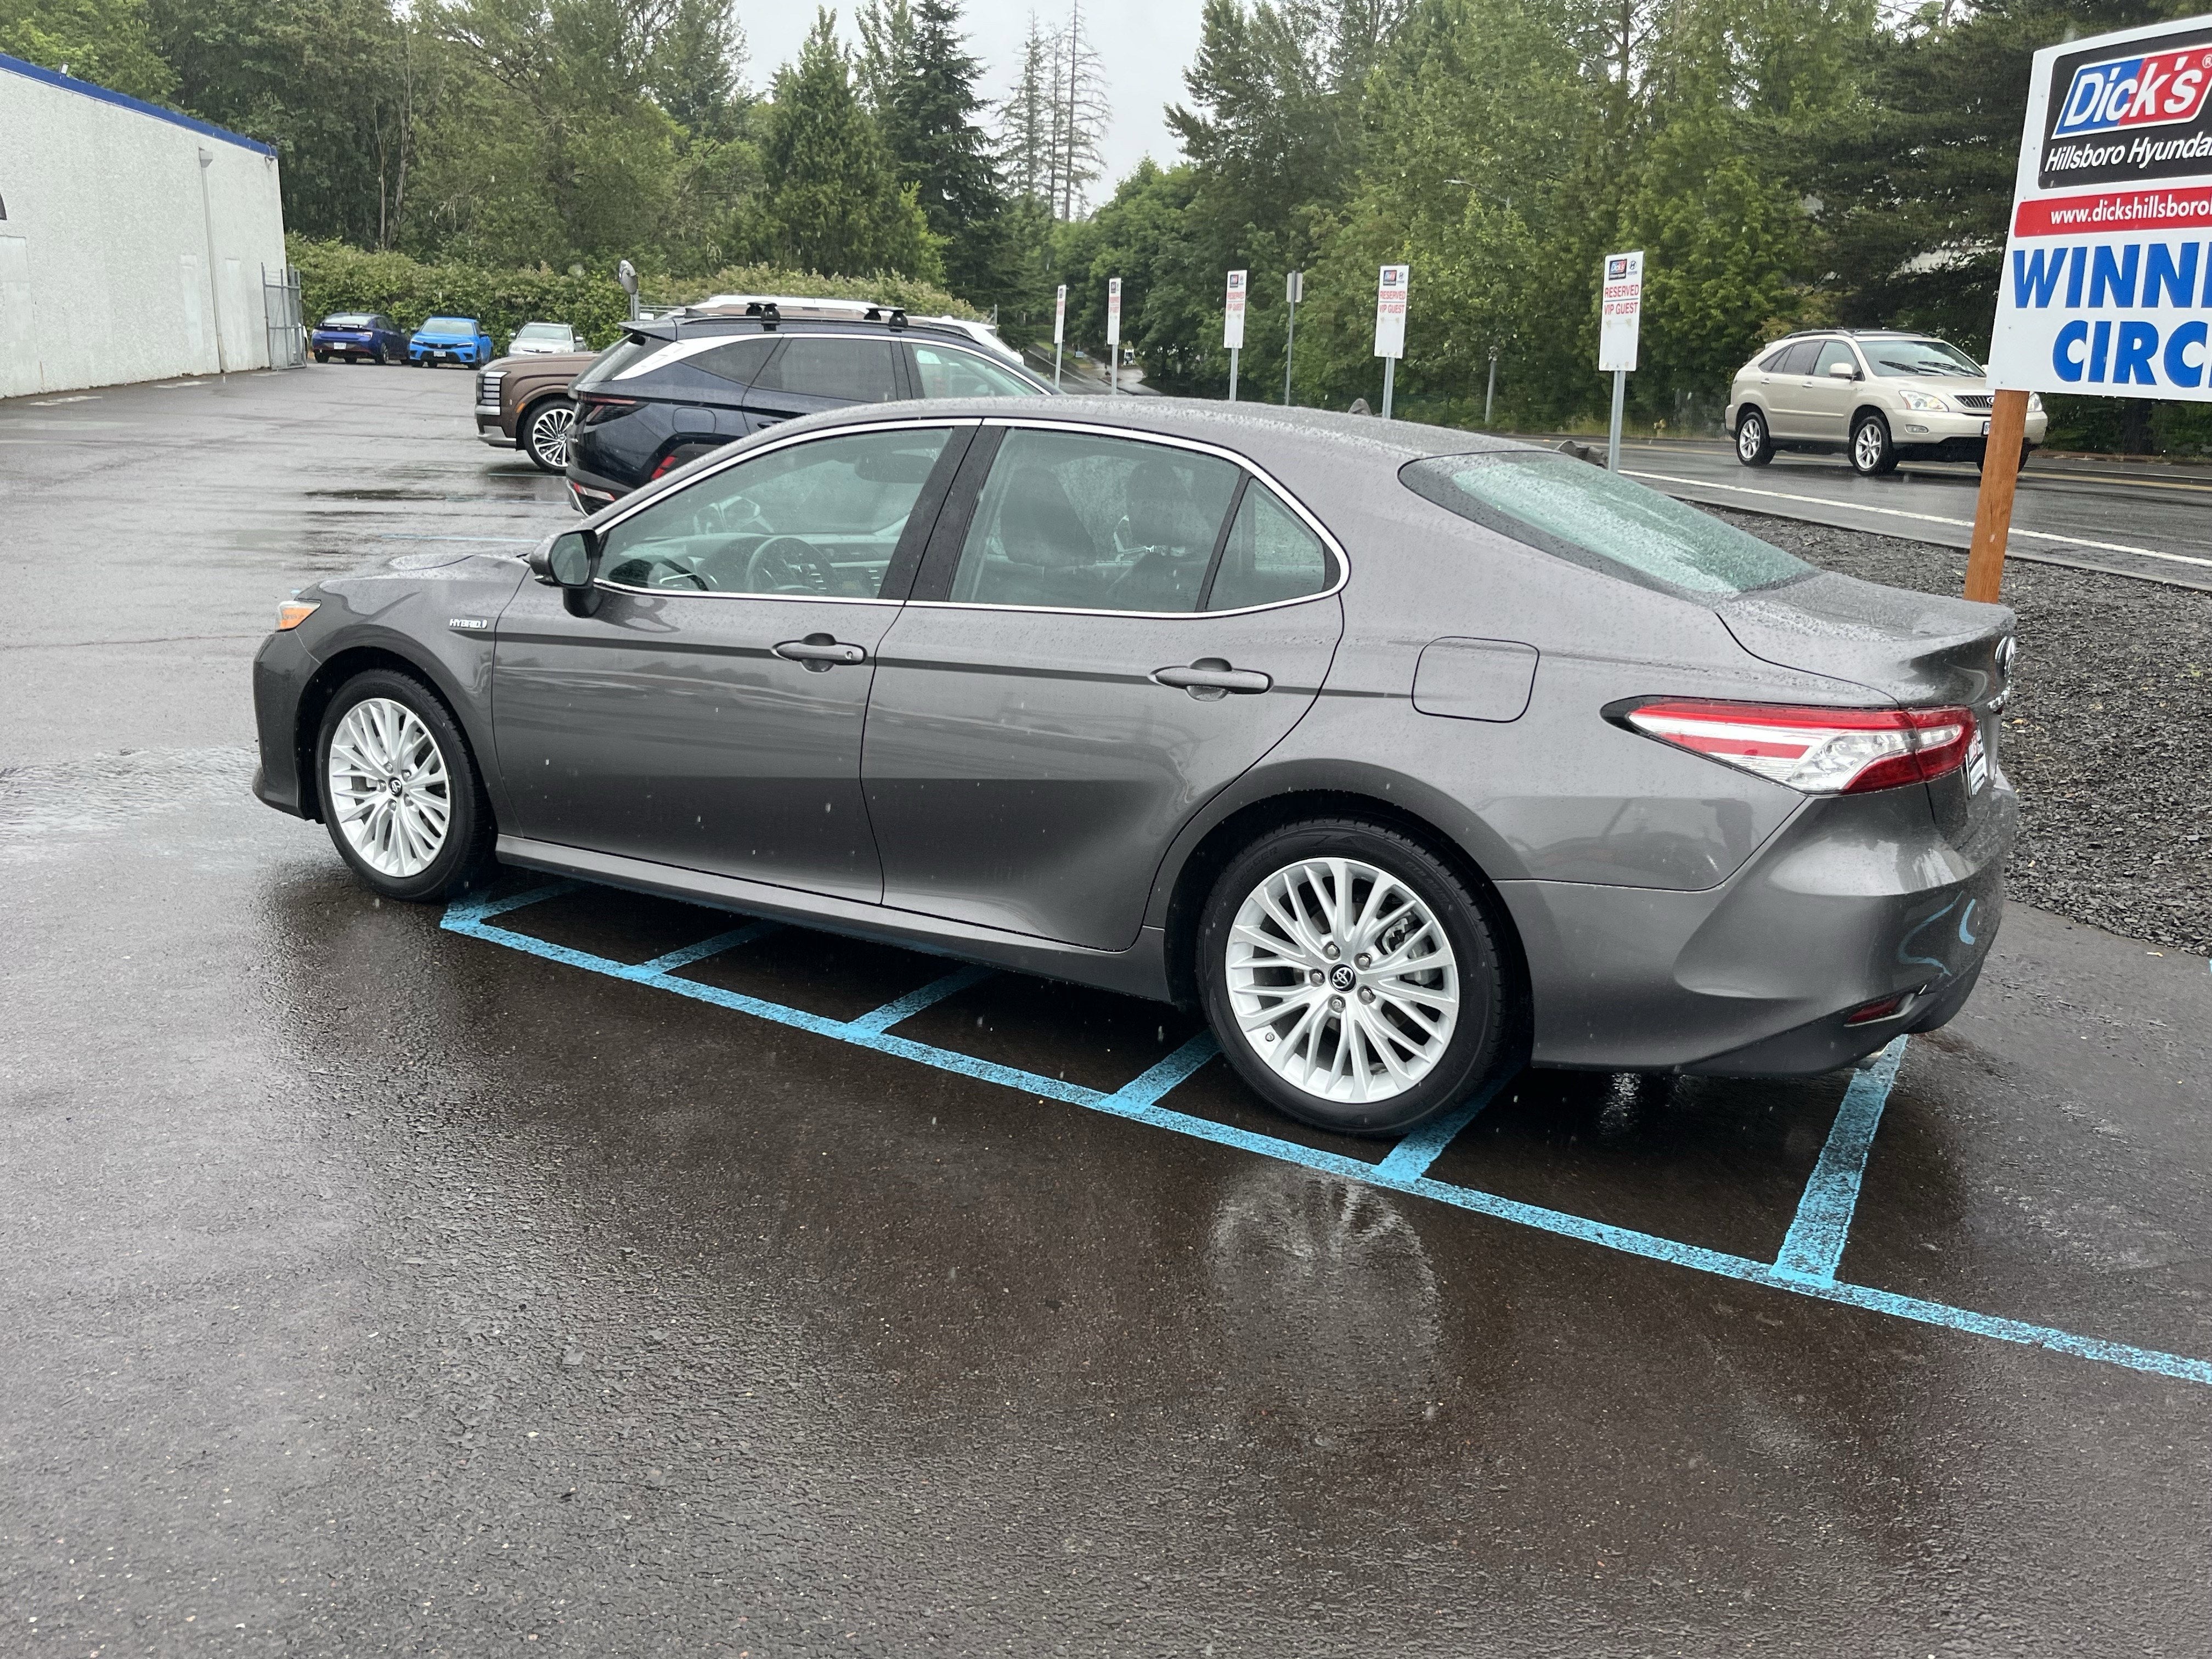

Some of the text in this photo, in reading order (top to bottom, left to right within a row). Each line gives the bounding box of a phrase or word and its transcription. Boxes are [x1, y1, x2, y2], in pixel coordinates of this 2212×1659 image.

[2063, 57, 2203, 127] Dick's
[2044, 143, 2125, 172] Hillsboro
[2051, 194, 2212, 224] www.dickshillsboro
[2013, 242, 2212, 308] WINN
[1605, 285, 1639, 298] RESERVED
[1604, 302, 1638, 315] VIP GUEST
[2052, 320, 2212, 388] CIRC
[449, 618, 482, 628] HYBRID
